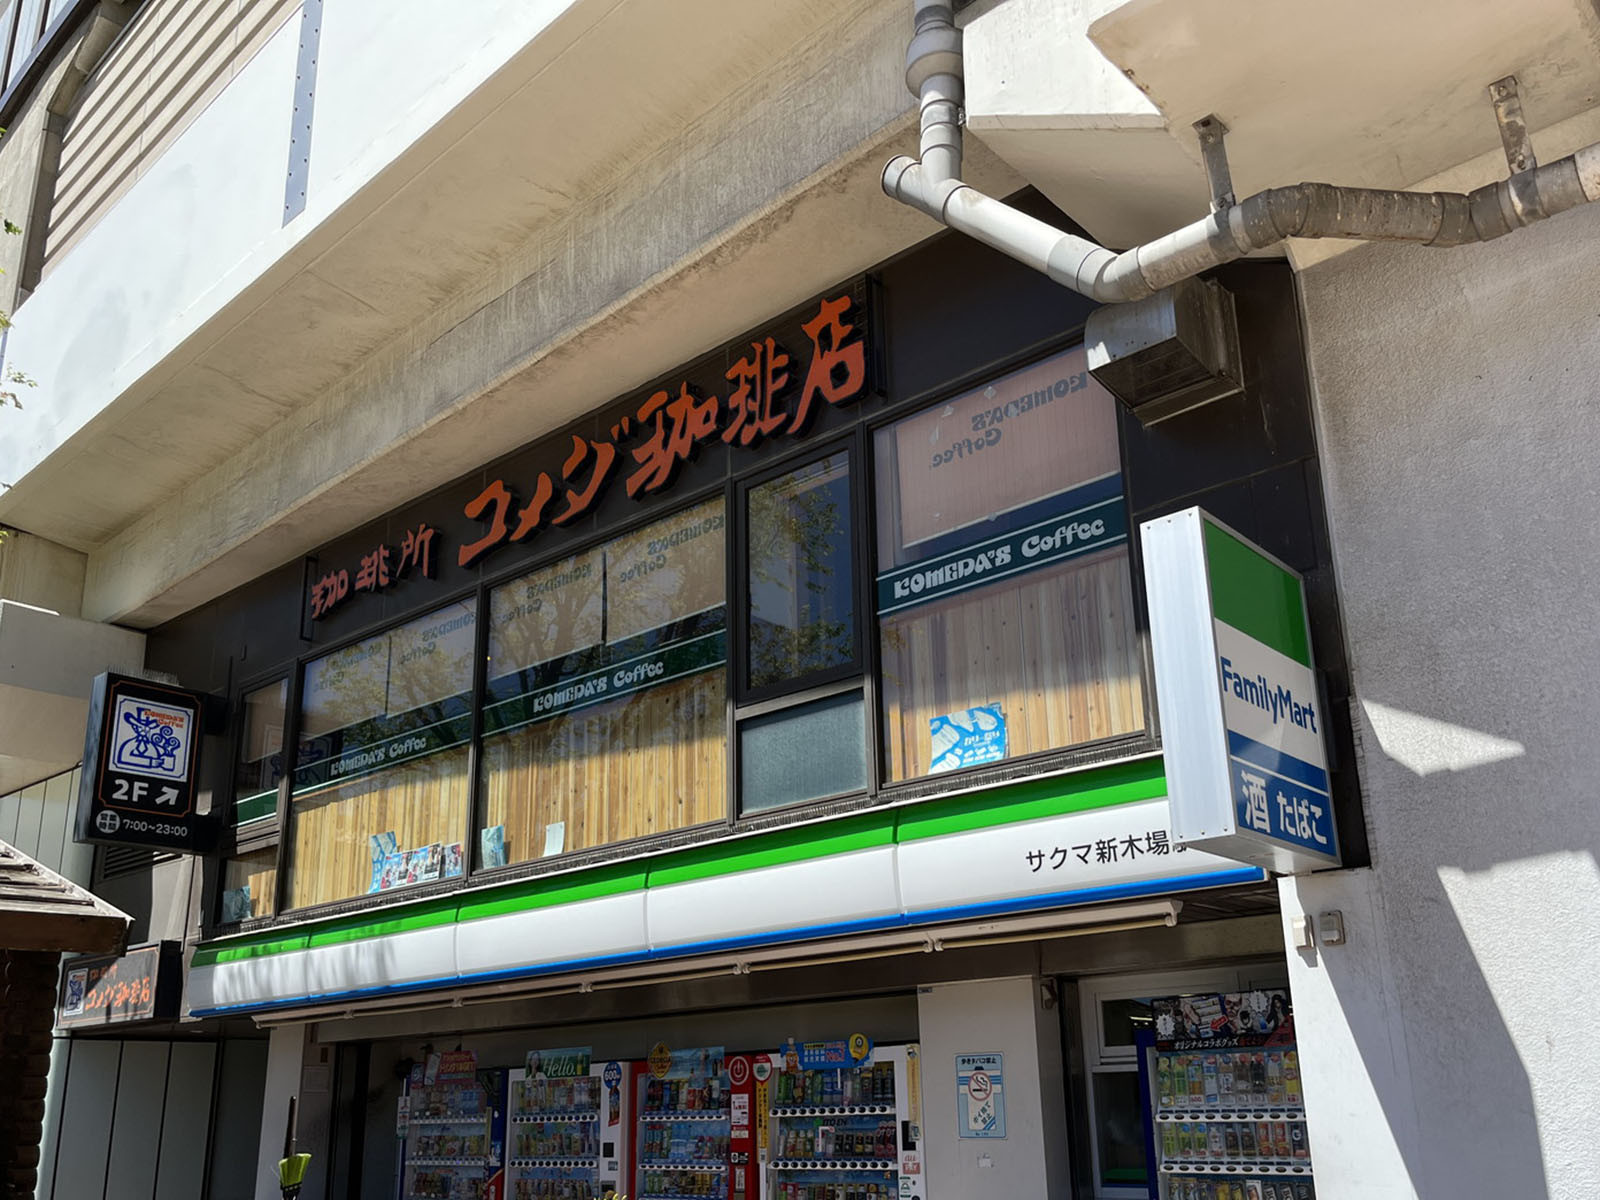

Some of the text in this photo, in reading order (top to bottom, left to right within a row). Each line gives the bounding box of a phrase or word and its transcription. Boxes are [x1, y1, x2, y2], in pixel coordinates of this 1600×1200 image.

[458, 295, 866, 566] コメダ珈琲店
[894, 518, 1105, 600] KOMEDA'S Coffee
[533, 661, 664, 713] KOMEDA'S Coffee
[1220, 656, 1317, 734] FamilyMart
[389, 737, 427, 758] Coffee
[111, 779, 149, 803] 2F
[1242, 769, 1327, 845] 酒 たばこ
